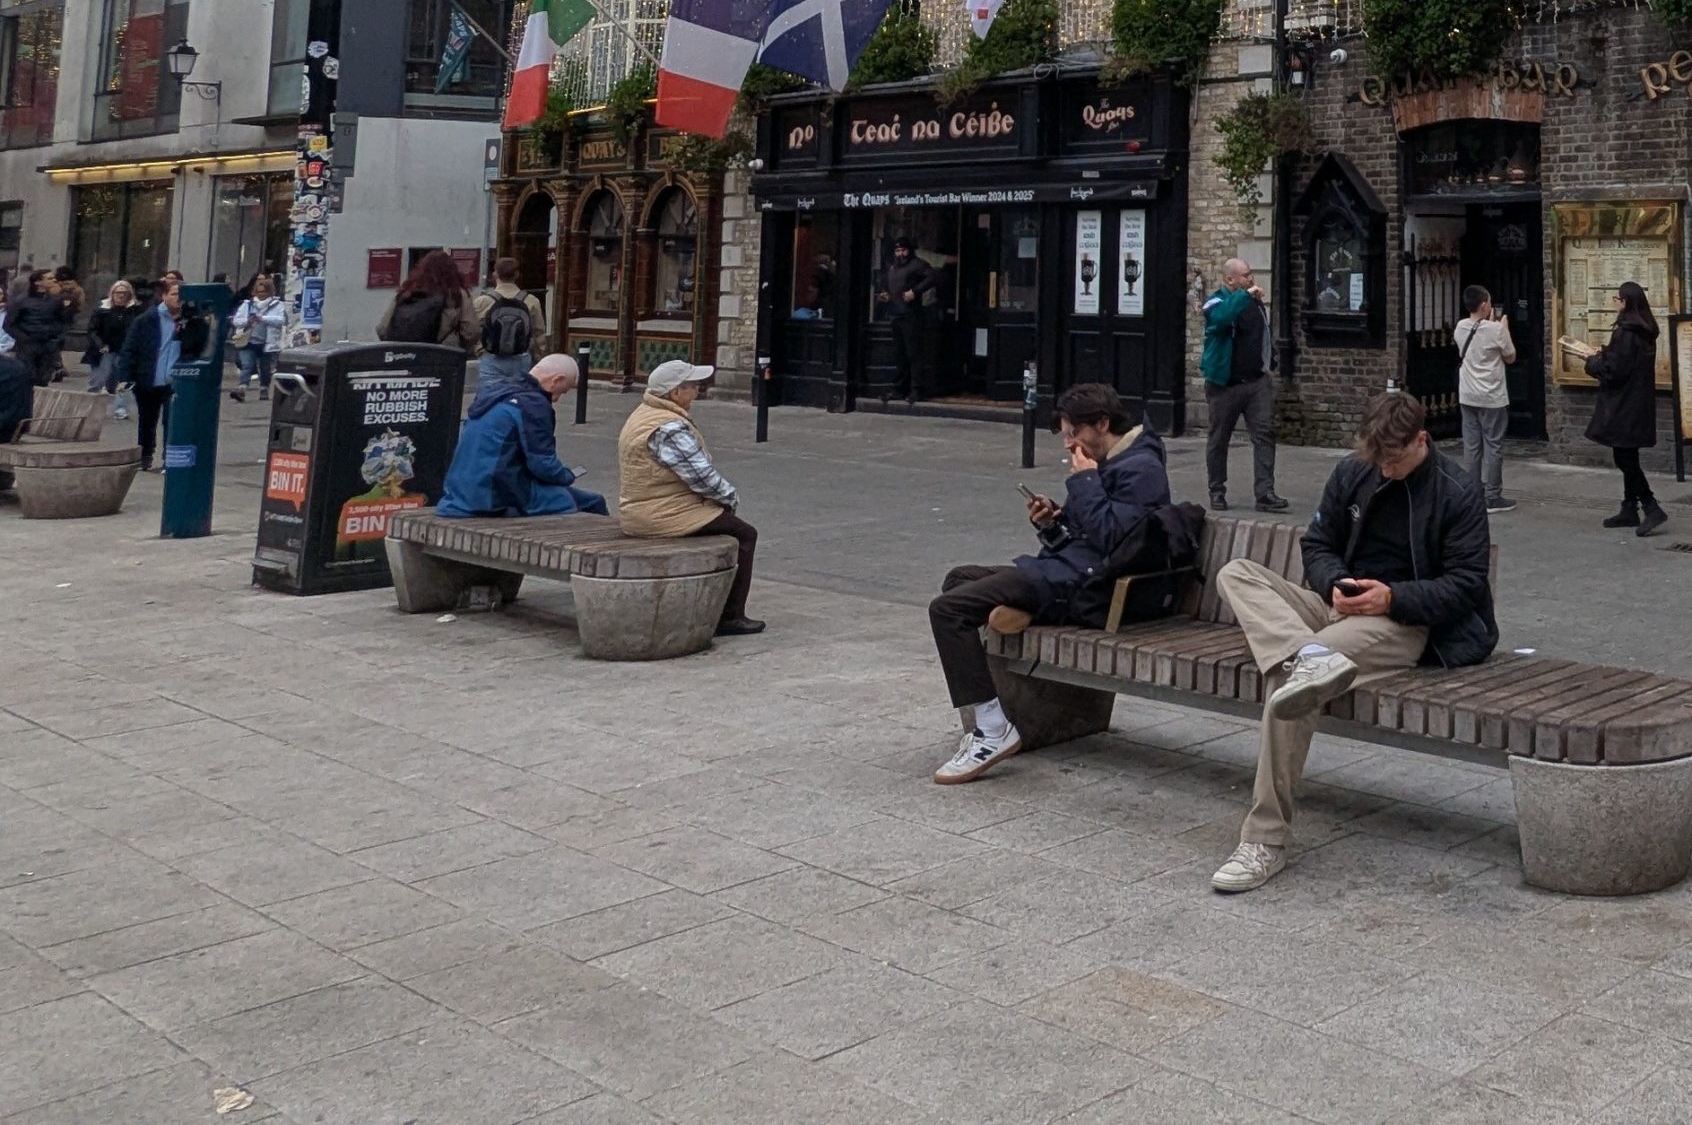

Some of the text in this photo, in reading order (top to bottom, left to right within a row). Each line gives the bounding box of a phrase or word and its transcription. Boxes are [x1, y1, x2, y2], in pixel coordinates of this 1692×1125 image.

[1499, 59, 1579, 98] BAR
[1083, 105, 1135, 129] Quays
[911, 120, 940, 142] na
[844, 193, 859, 207] The
[862, 192, 890, 207] Quays
[924, 193, 948, 205] Tourist
[949, 192, 961, 204] Bar
[961, 191, 987, 203] Winner
[987, 191, 1006, 202] 2024
[1007, 191, 1013, 201] &
[366, 389, 428, 402] NO MORE
[365, 401, 428, 414] RUBBISH
[363, 412, 429, 425] EXCUSES.
[270, 471, 304, 494] BIN IT.
[345, 514, 385, 535] BIN
